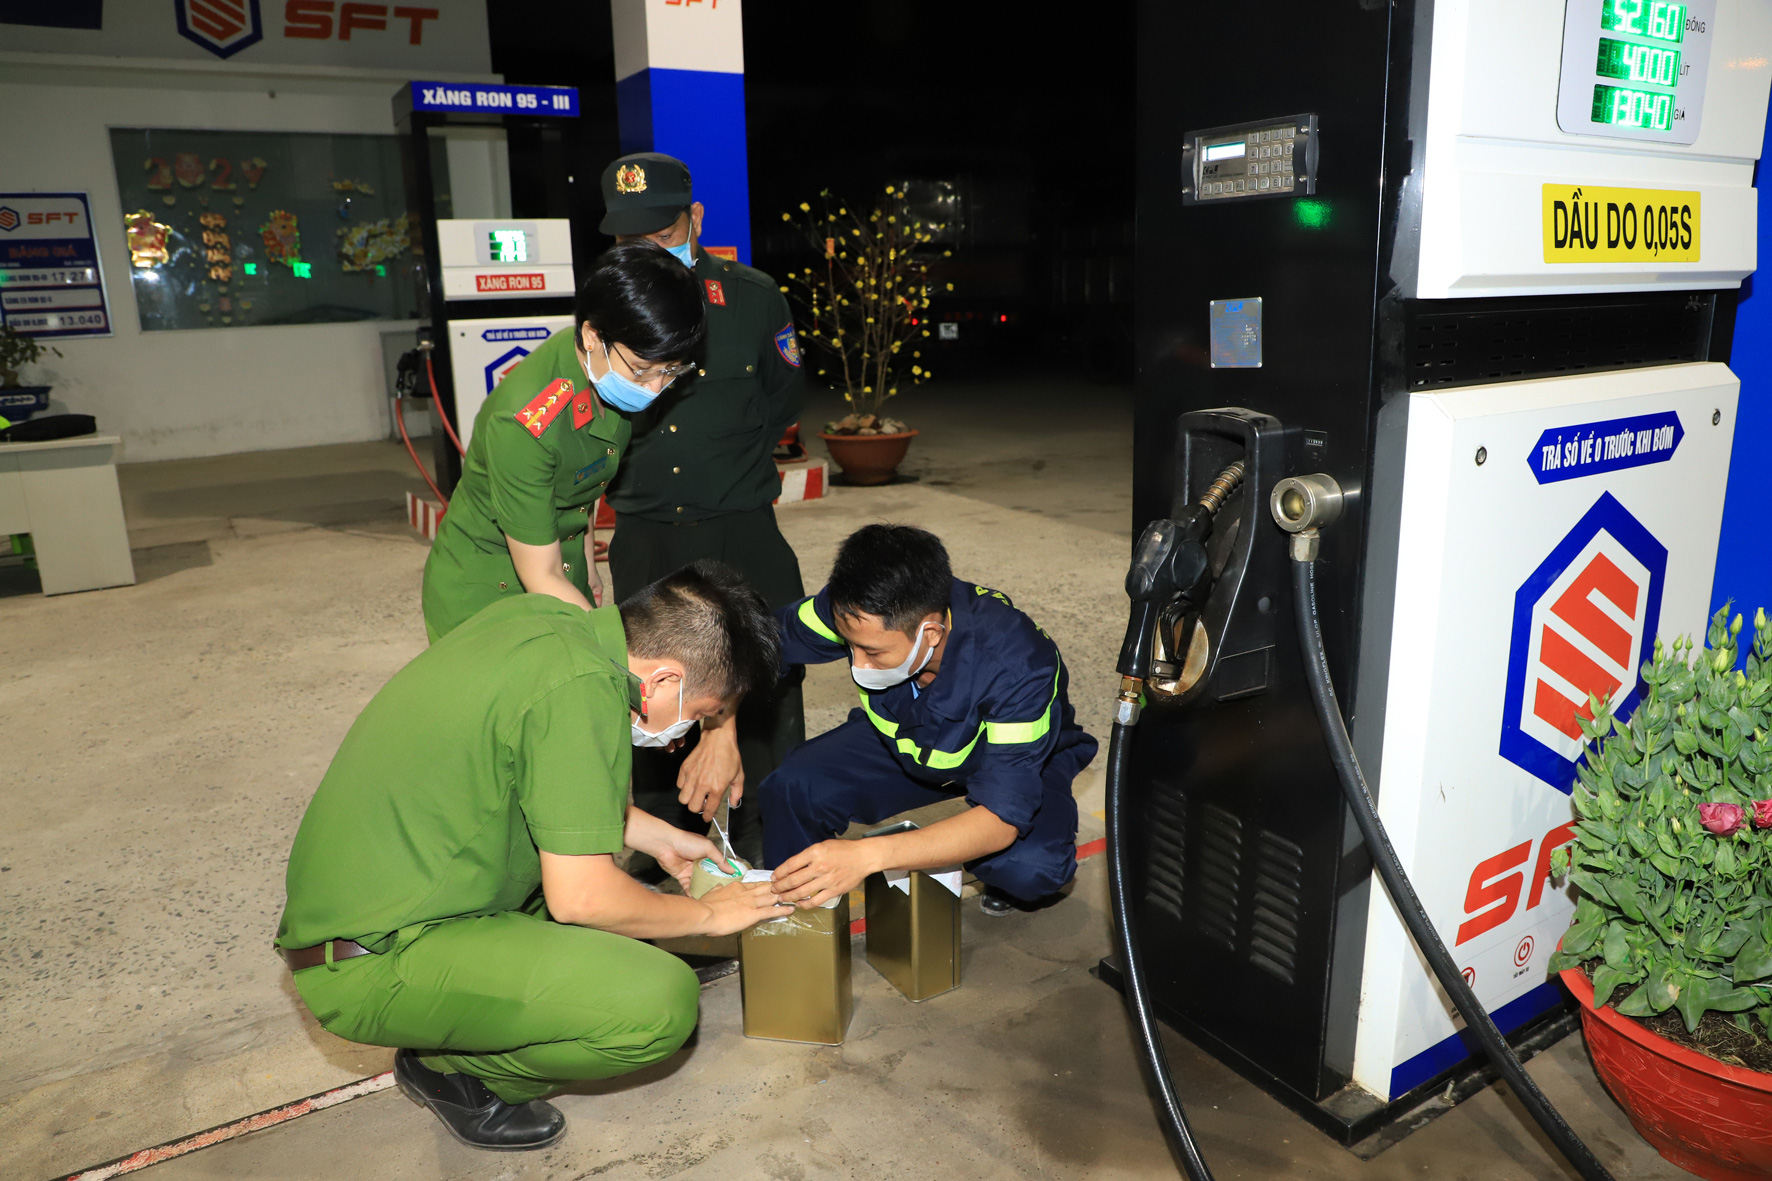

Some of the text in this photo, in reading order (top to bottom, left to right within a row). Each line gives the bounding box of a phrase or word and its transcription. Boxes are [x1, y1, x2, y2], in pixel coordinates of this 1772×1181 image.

[284, 0, 439, 45] SFT
[422, 87, 472, 106] XĂNG
[476, 91, 512, 108] RON
[516, 93, 538, 109] 95
[552, 94, 570, 110] III
[1611, 88, 1672, 130] 13040
[27, 212, 79, 225] SFT
[1553, 188, 1692, 257] DẦU DO 0,05S
[479, 275, 543, 290] XĂNG RON 95
[60, 315, 102, 326] 13.040
[1541, 435, 1562, 471] TRẢ
[1563, 431, 1581, 468] SỐ
[1580, 430, 1595, 464] VỀ
[1603, 428, 1635, 461] TRƯỚC
[1635, 429, 1652, 455] KHI
[1652, 424, 1675, 452] BƠM
[1455, 819, 1584, 947] SF
